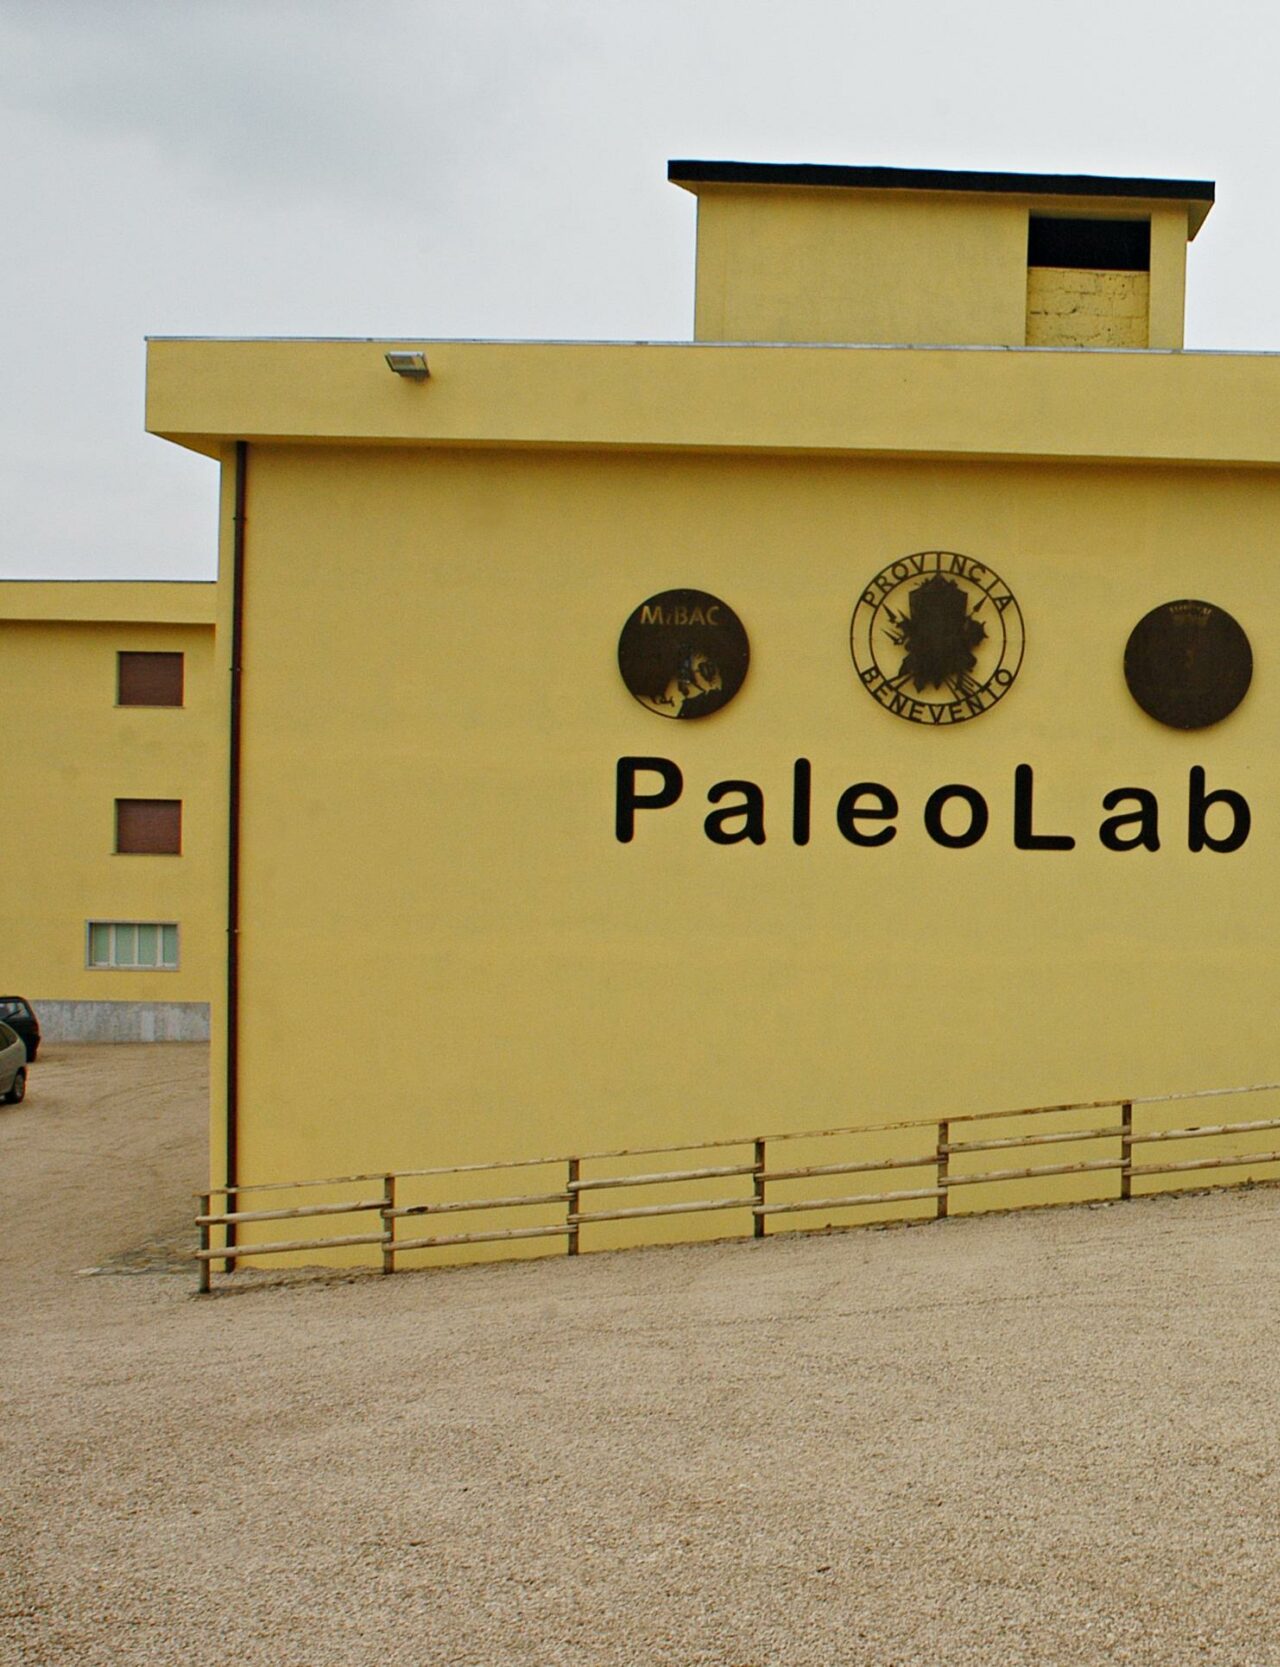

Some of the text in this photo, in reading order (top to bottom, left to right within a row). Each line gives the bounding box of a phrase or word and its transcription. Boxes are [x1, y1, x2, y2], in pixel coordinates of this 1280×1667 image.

[860, 553, 1015, 611] PROVINCIA
[859, 665, 1014, 724] BENEVENTO
[615, 756, 1251, 853] PaleoLab
